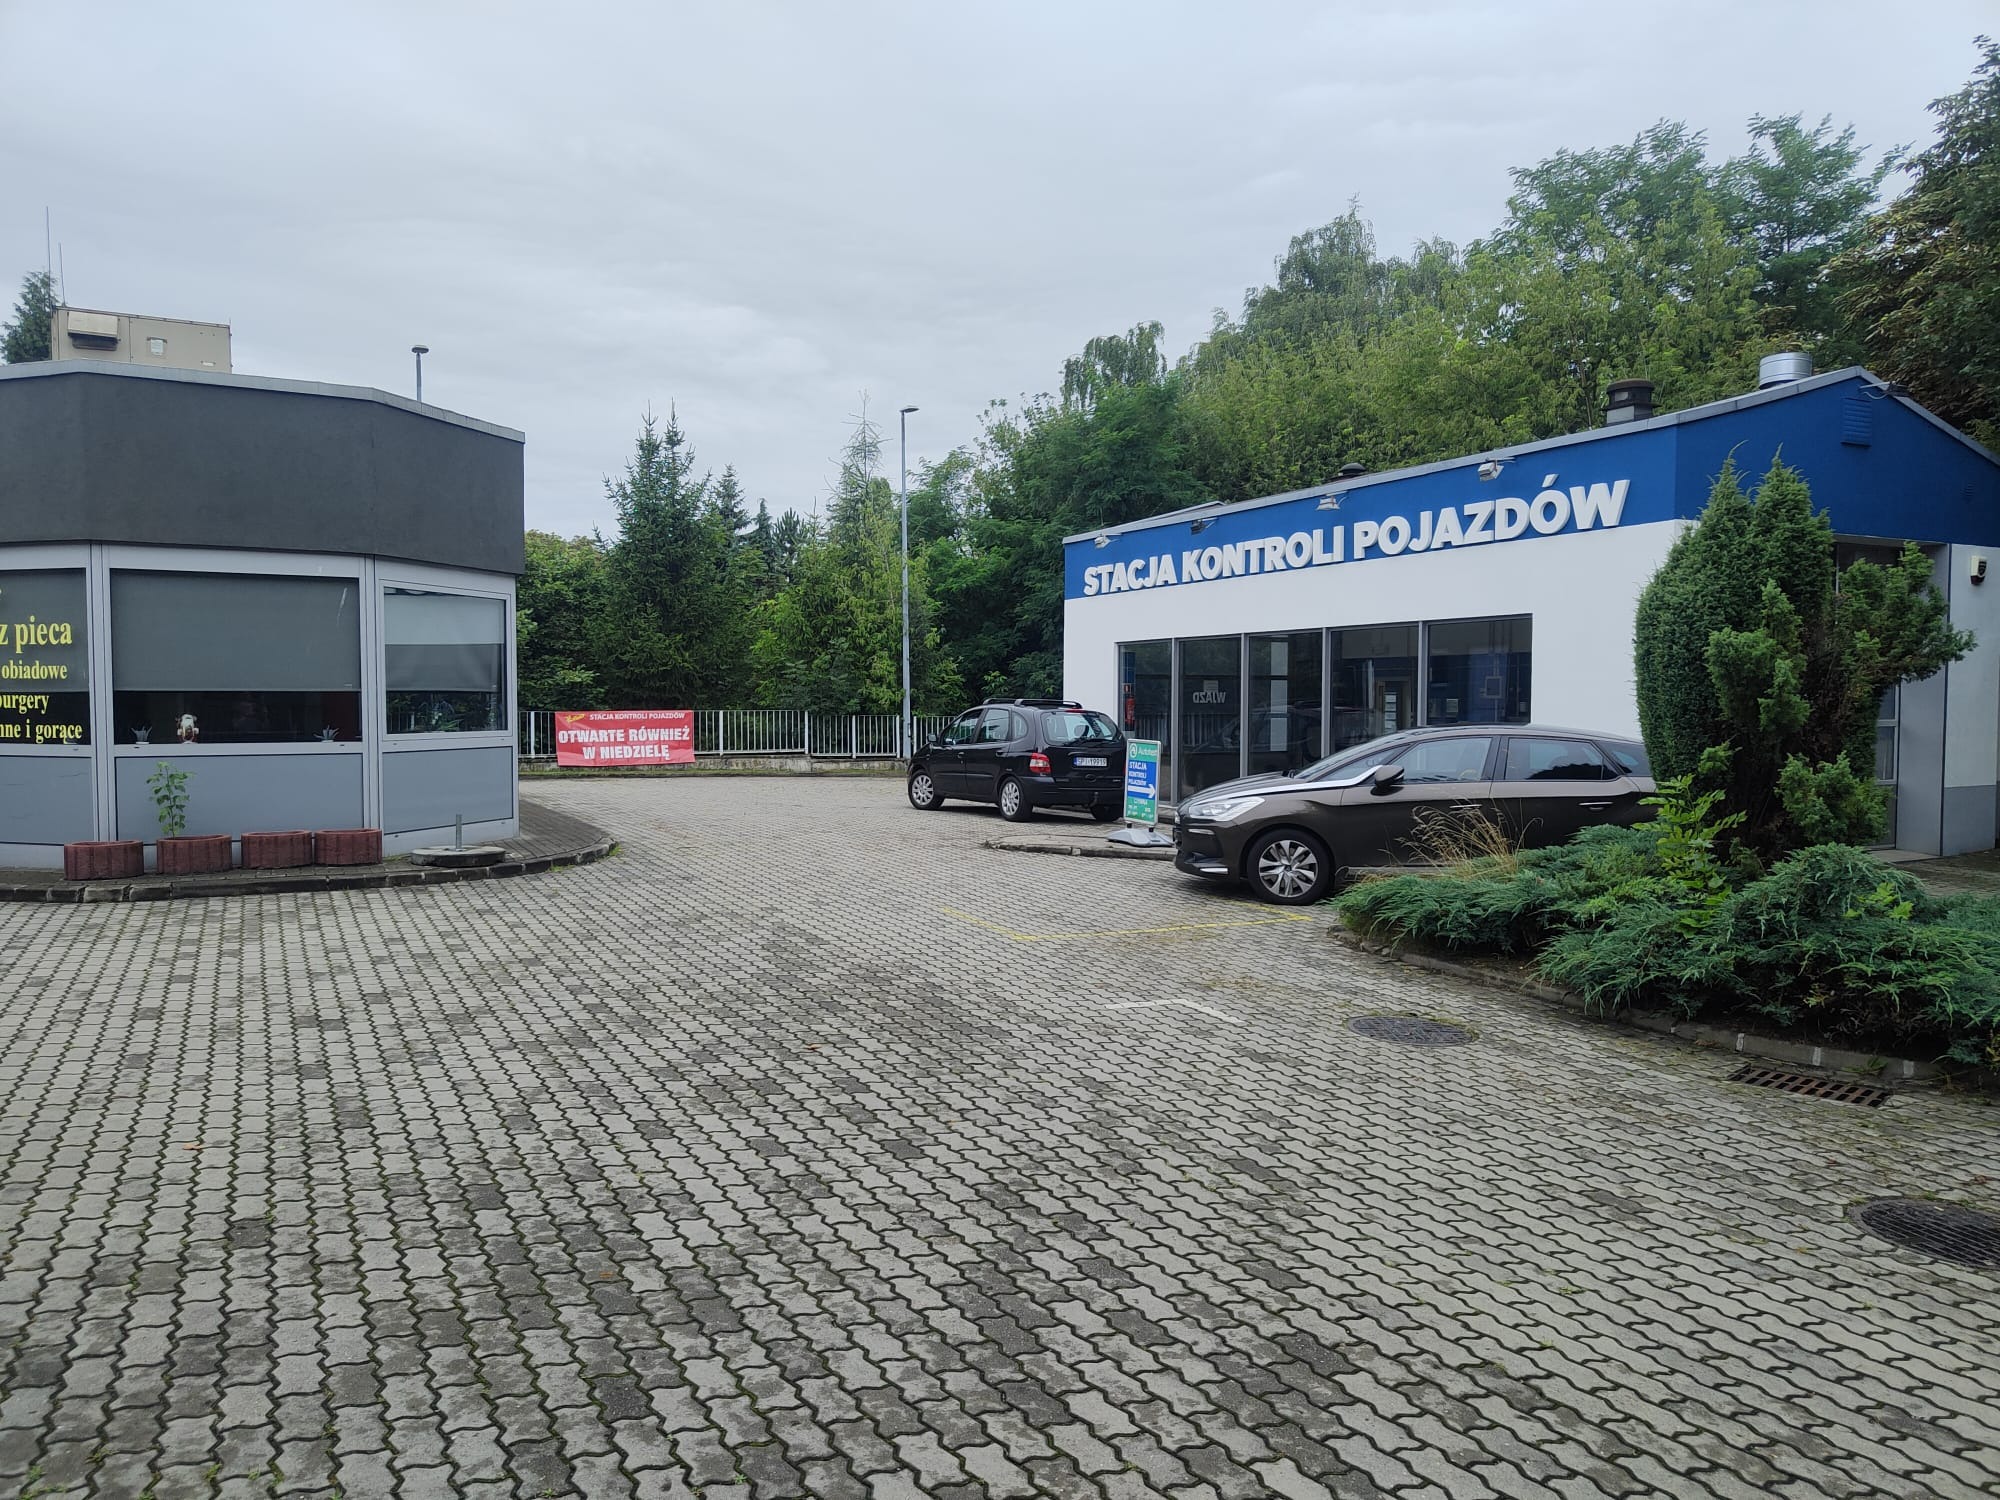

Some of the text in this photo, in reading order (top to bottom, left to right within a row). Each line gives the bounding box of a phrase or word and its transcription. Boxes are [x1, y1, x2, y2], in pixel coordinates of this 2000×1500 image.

[1083, 473, 1631, 596] STACJA KONTROLI POJAZDÓW
[14, 615, 72, 653] pieca
[1, 660, 67, 679] obiadowe
[589, 713, 614, 721] STACJA
[26, 718, 31, 738] i
[35, 724, 83, 745] gorące
[559, 726, 689, 743] OTWARTE RÓWNIEŻ
[583, 745, 669, 760] W NIEDZIELĘ
[1129, 761, 1147, 770] STACJA
